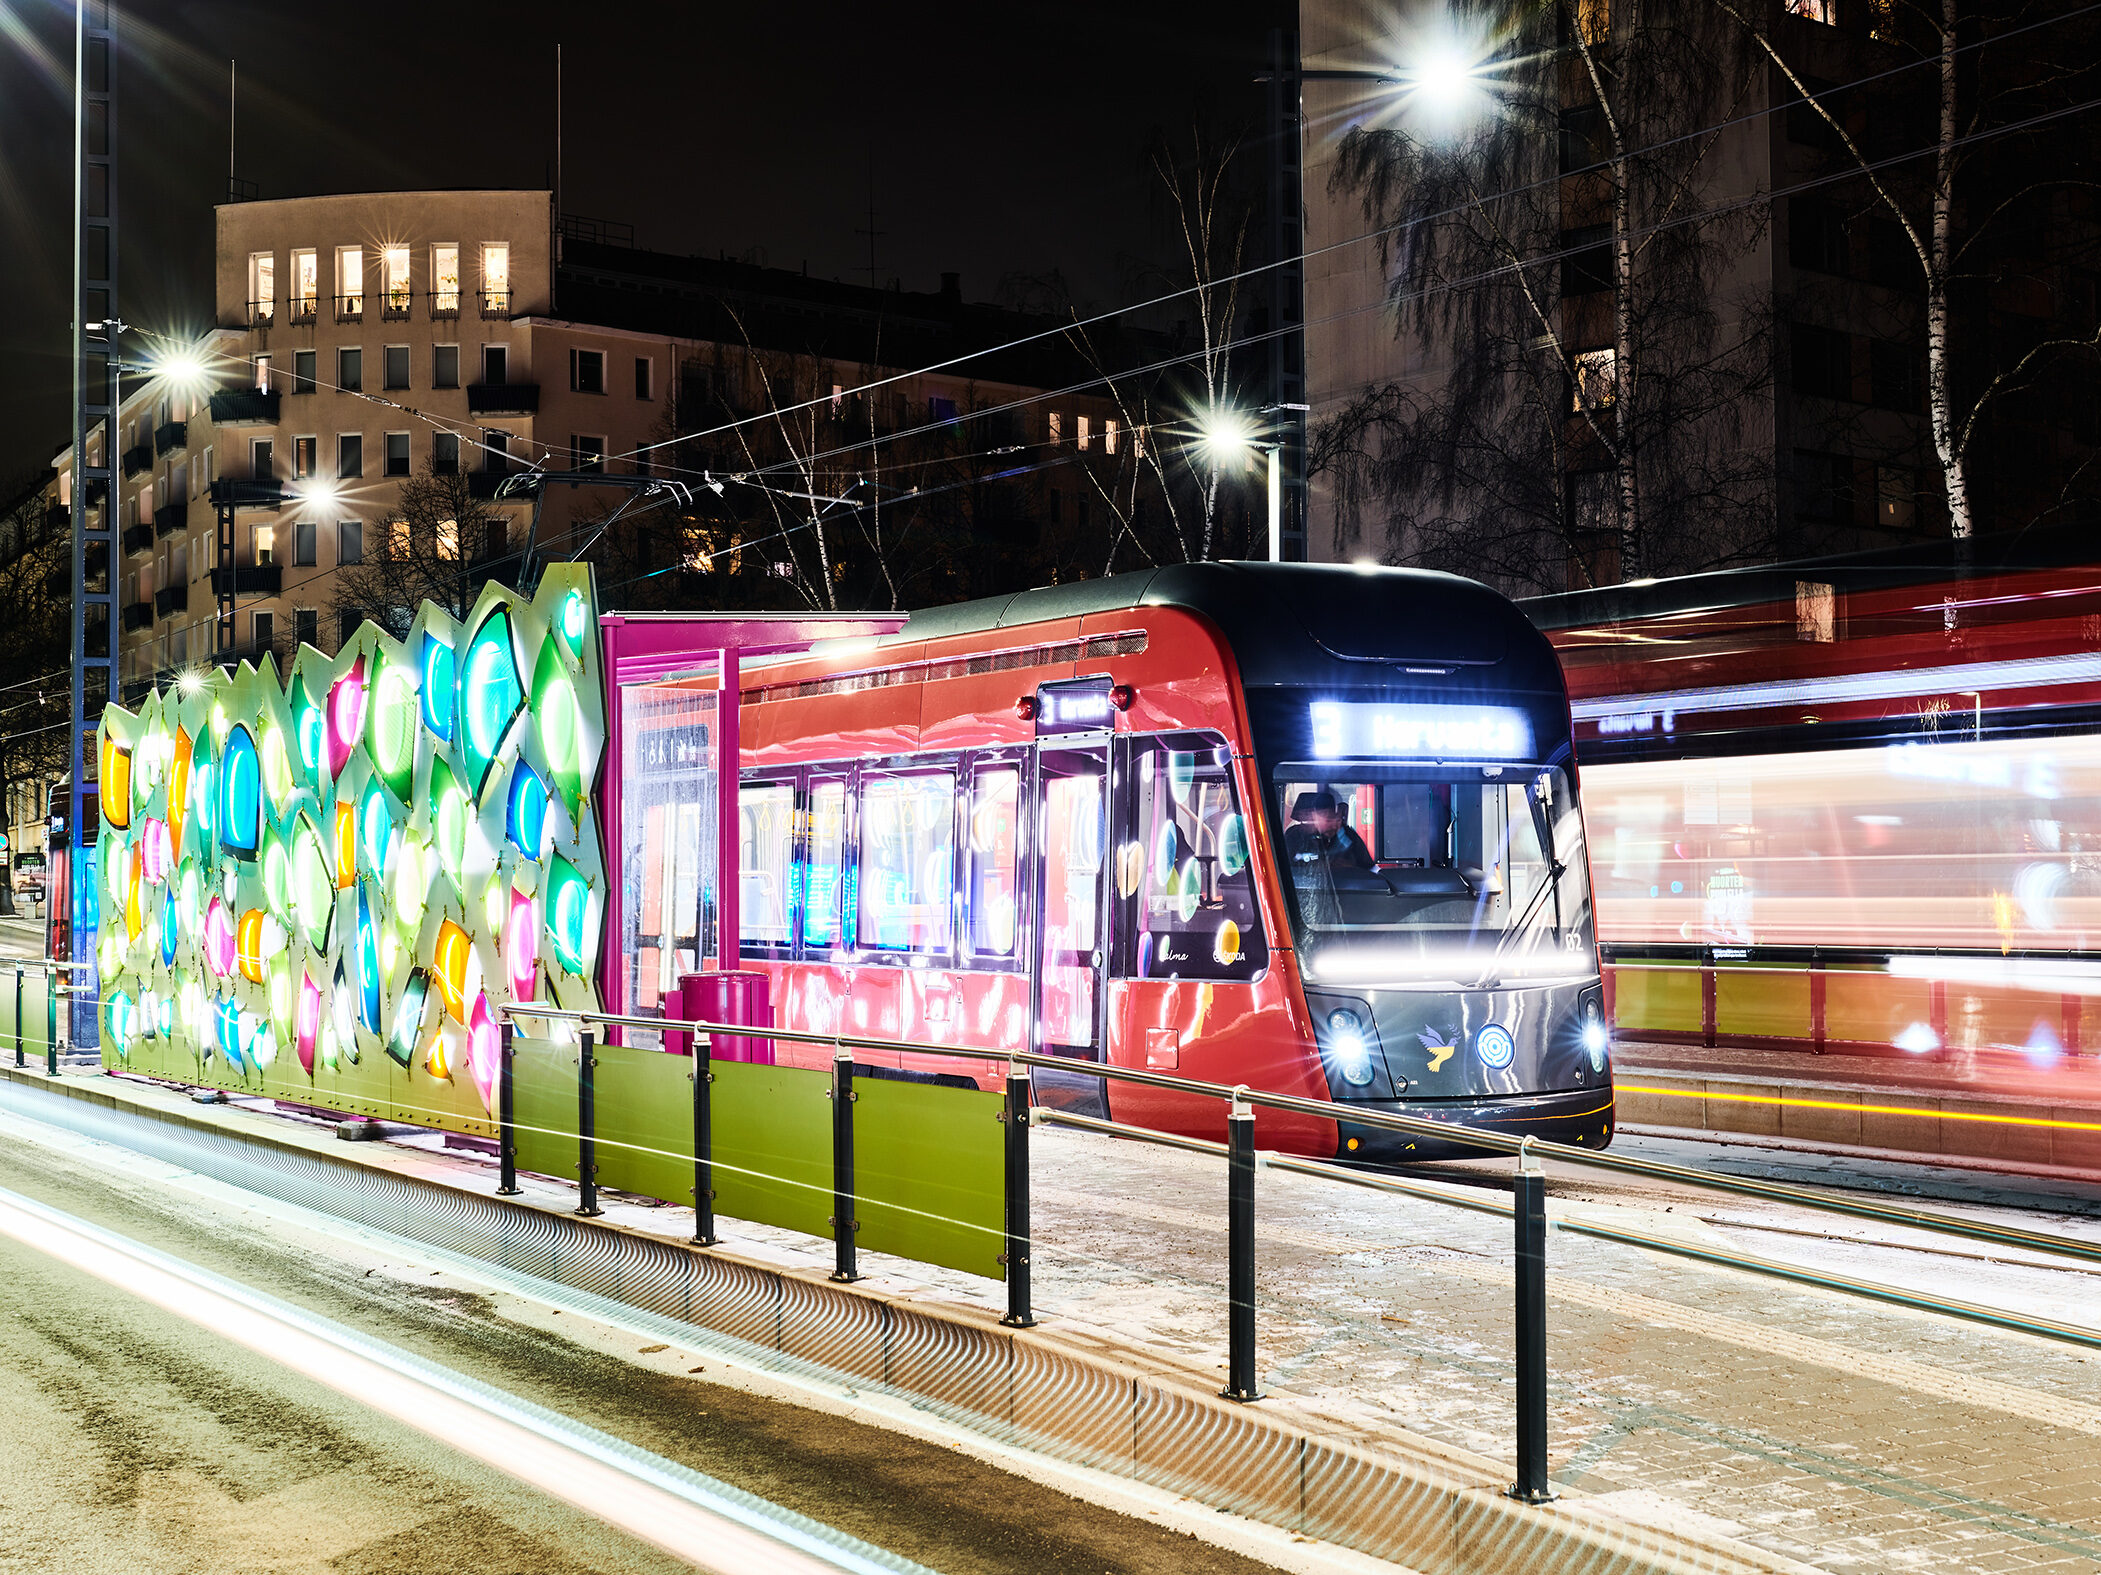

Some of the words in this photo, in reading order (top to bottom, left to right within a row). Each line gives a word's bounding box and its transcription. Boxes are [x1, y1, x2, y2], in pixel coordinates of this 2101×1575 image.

[1314, 706, 1341, 756] 3
[1565, 933, 1584, 952] 02
[1159, 949, 1189, 962] alma
[1223, 950, 1246, 962] ŠKODA
